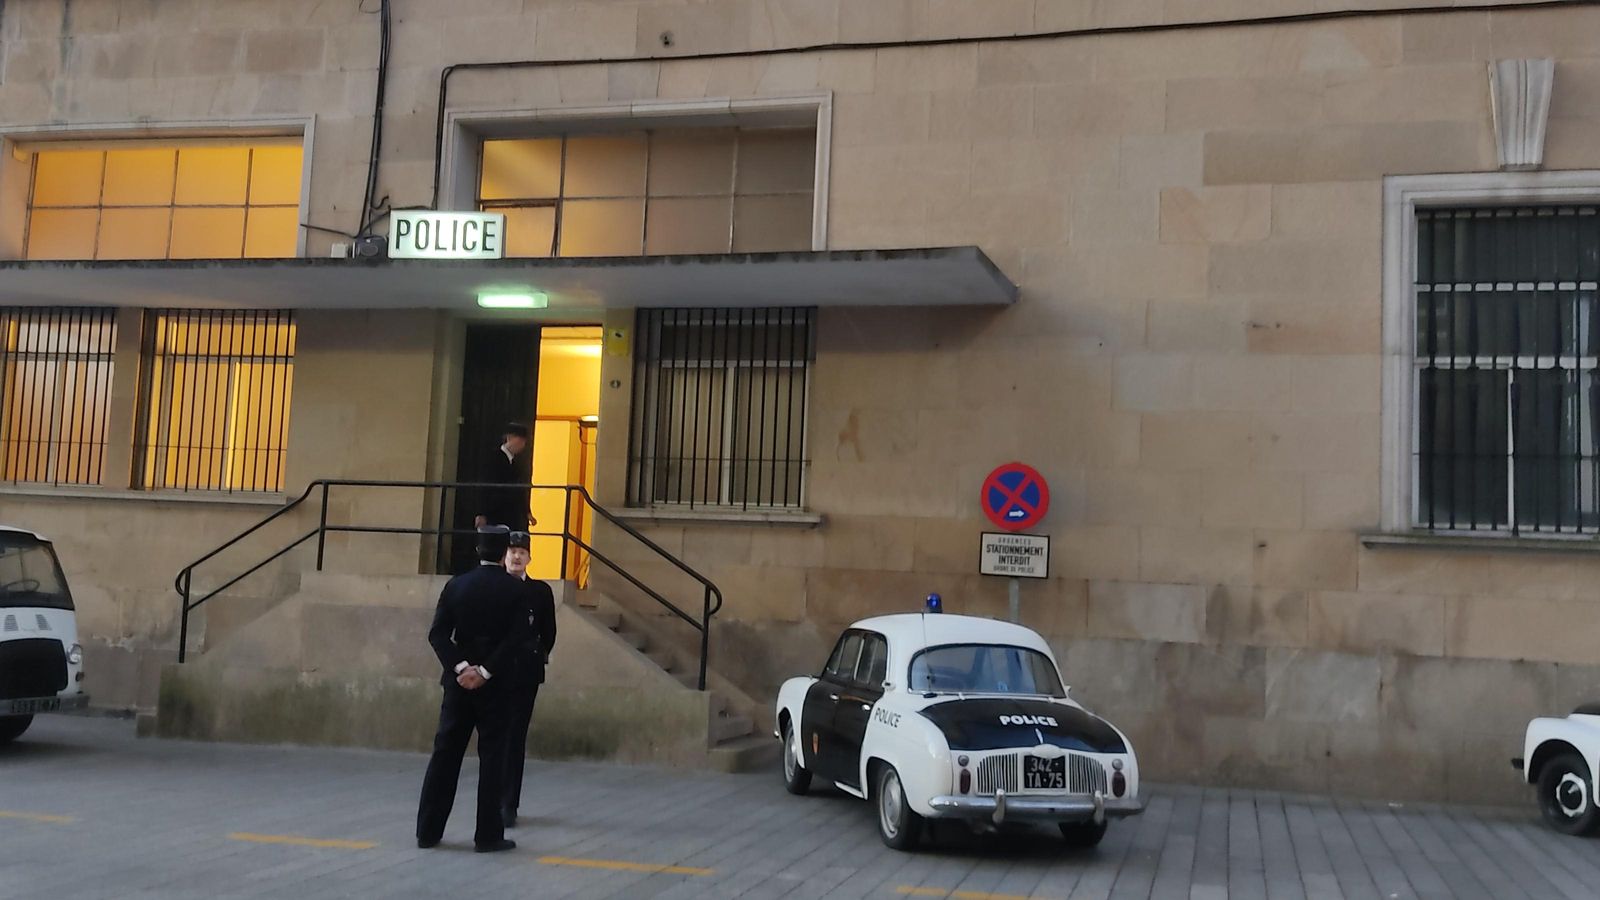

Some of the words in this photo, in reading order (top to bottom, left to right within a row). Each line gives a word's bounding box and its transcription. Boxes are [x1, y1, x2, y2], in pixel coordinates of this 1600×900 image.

[395, 219, 497, 252] POLICE
[986, 544, 1043, 556] STATIONNEMENT
[998, 555, 1031, 566] INTERDIT
[874, 707, 901, 728] POLICE
[999, 715, 1059, 727] POLICE
[1031, 757, 1052, 772] 342
